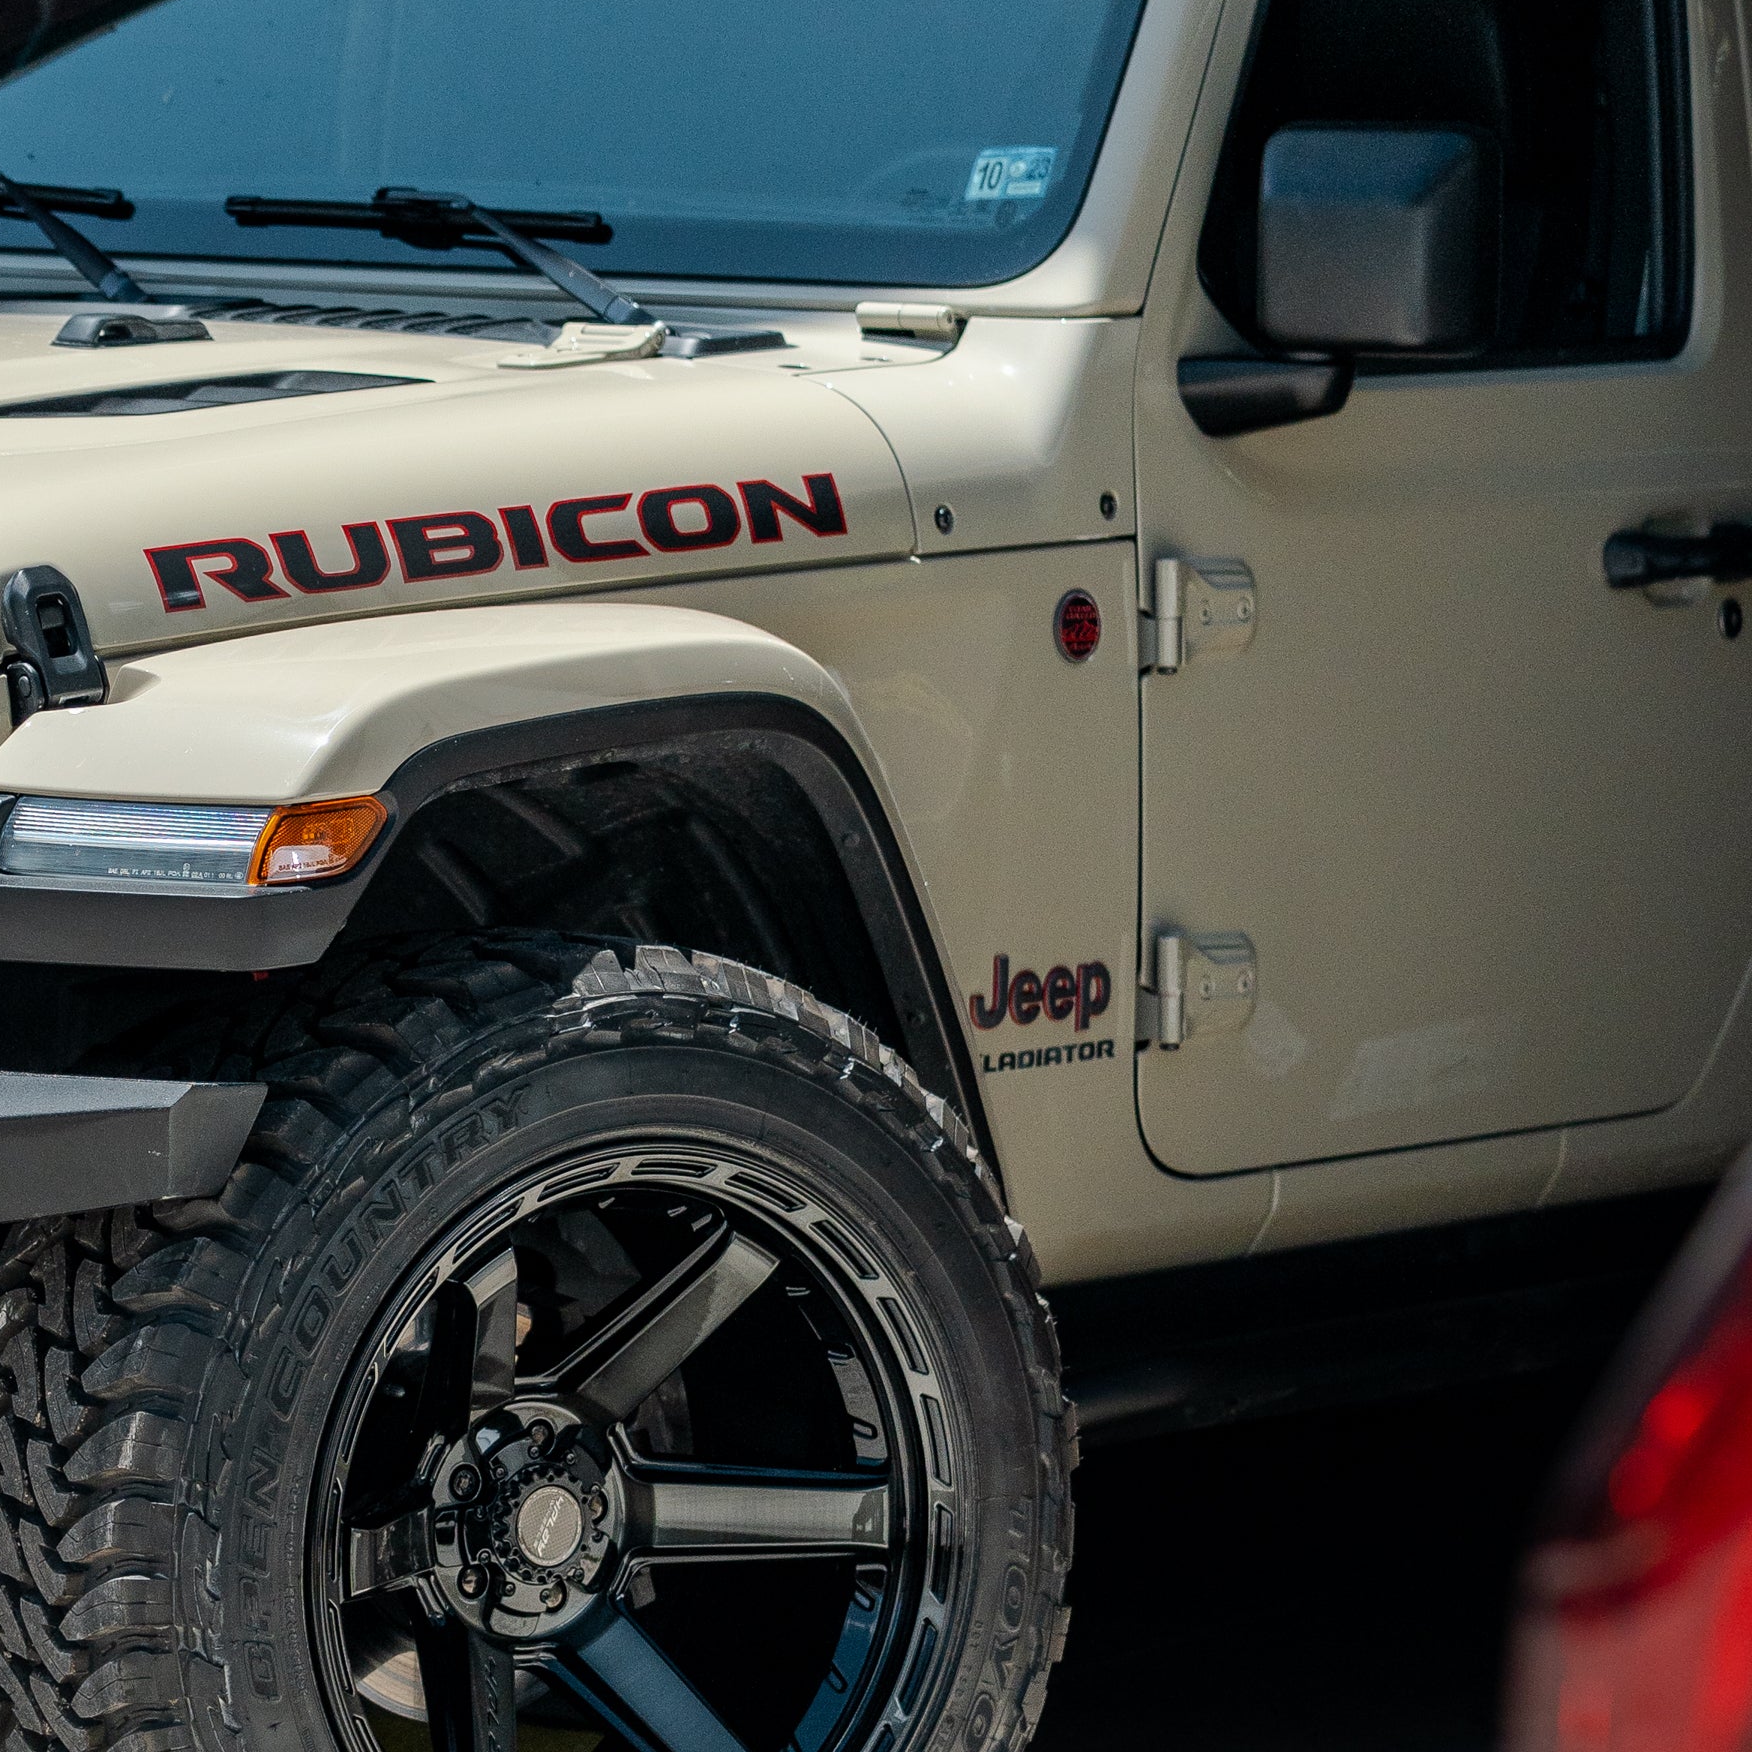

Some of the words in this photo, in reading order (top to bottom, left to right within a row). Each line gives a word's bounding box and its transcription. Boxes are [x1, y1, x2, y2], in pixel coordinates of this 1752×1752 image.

[978, 160, 1003, 191] 10
[143, 472, 848, 613] RUBICON
[968, 953, 1112, 1033] Jeep
[982, 1038, 1115, 1073] LADIATOR
[266, 1082, 532, 1423] COUNTRY
